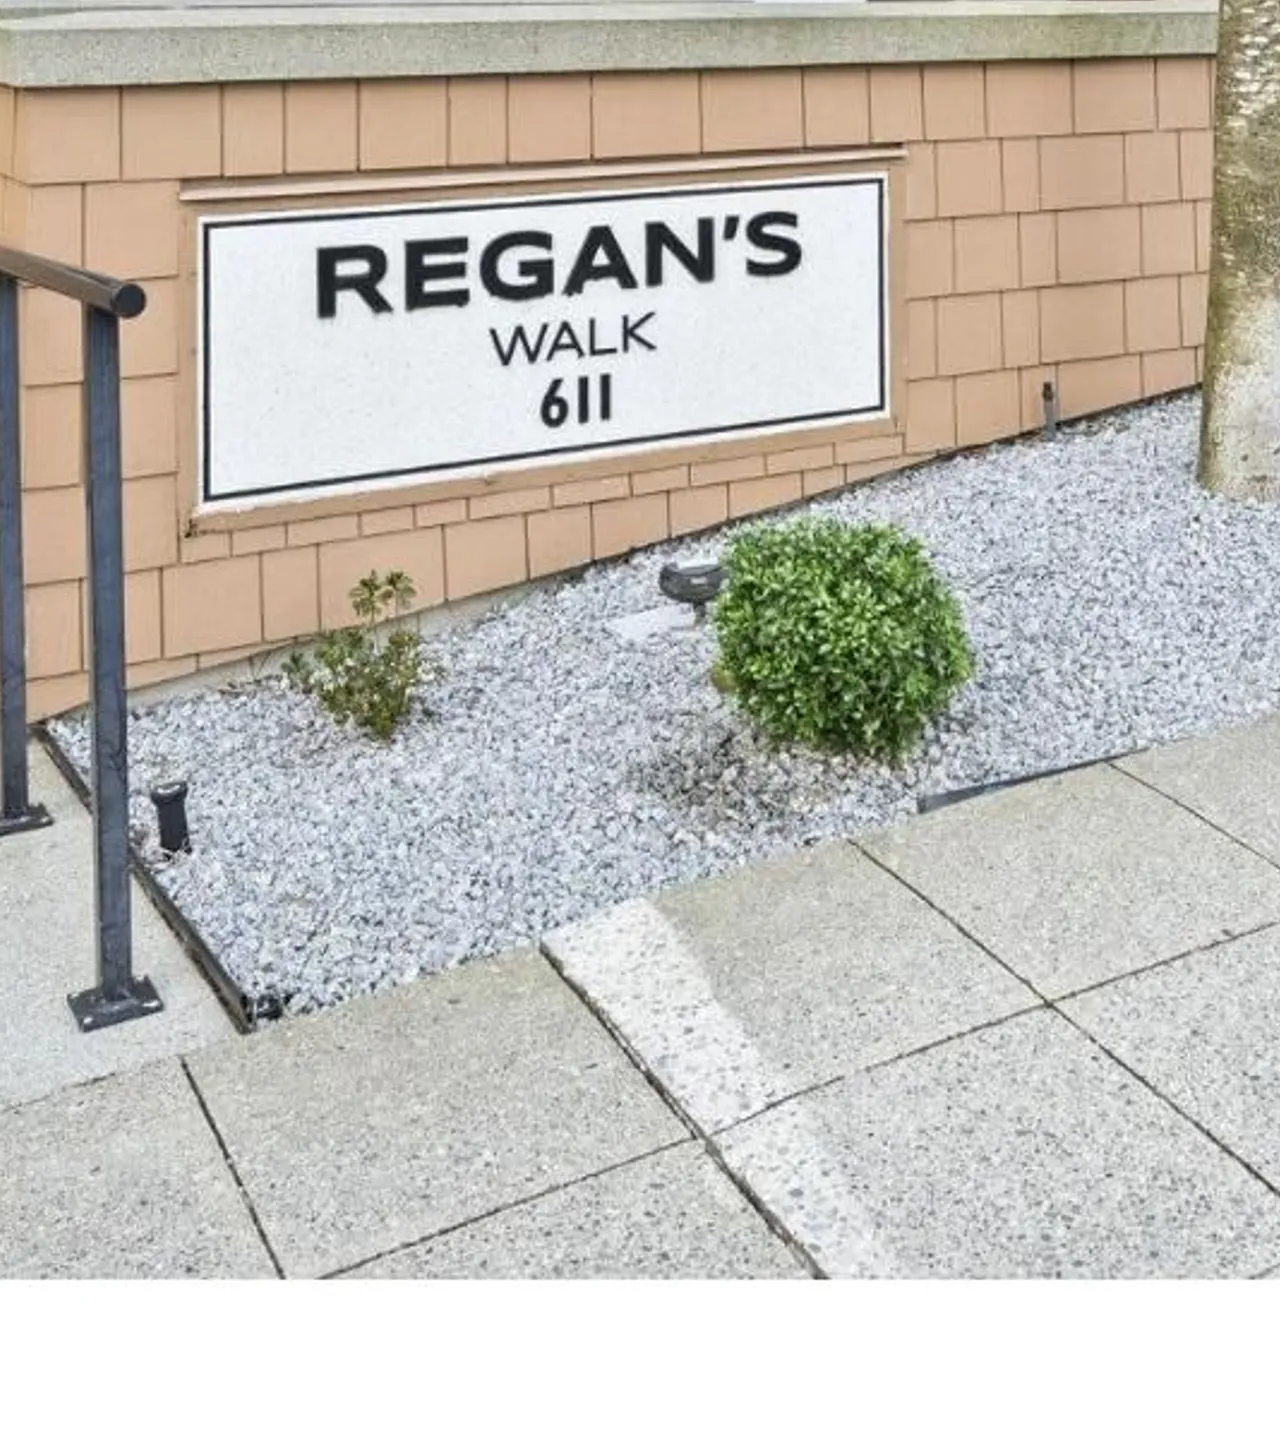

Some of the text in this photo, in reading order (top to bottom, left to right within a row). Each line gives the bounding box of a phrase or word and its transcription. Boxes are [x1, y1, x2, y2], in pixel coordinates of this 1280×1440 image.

[316, 210, 803, 320] REGAN'S
[488, 311, 657, 367] WALK
[539, 373, 613, 429] 611
